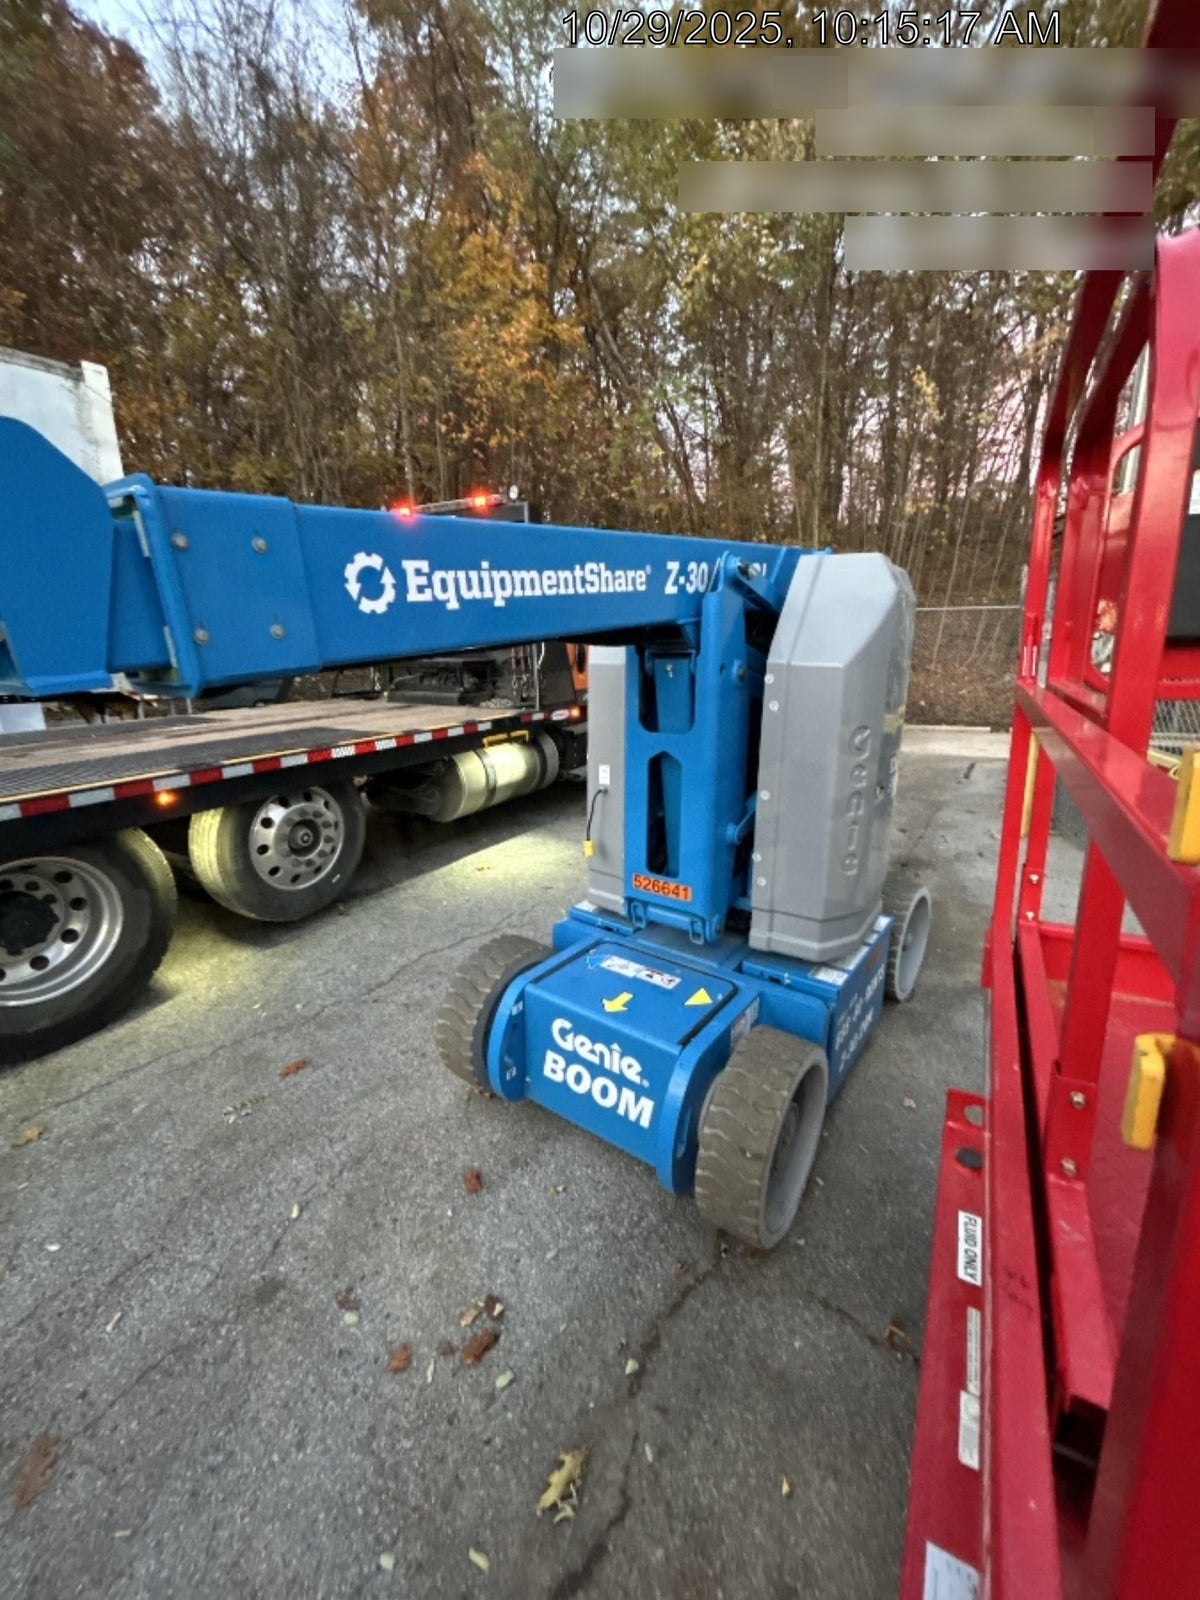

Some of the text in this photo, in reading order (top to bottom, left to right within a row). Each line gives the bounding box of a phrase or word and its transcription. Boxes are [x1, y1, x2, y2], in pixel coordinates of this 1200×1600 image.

[402, 559, 648, 610] EquipmentShare
[634, 874, 690, 901] 526641
[551, 1017, 645, 1086] Genie
[543, 1049, 655, 1129] BOOM
[963, 1215, 978, 1282] FLUID ONLY
